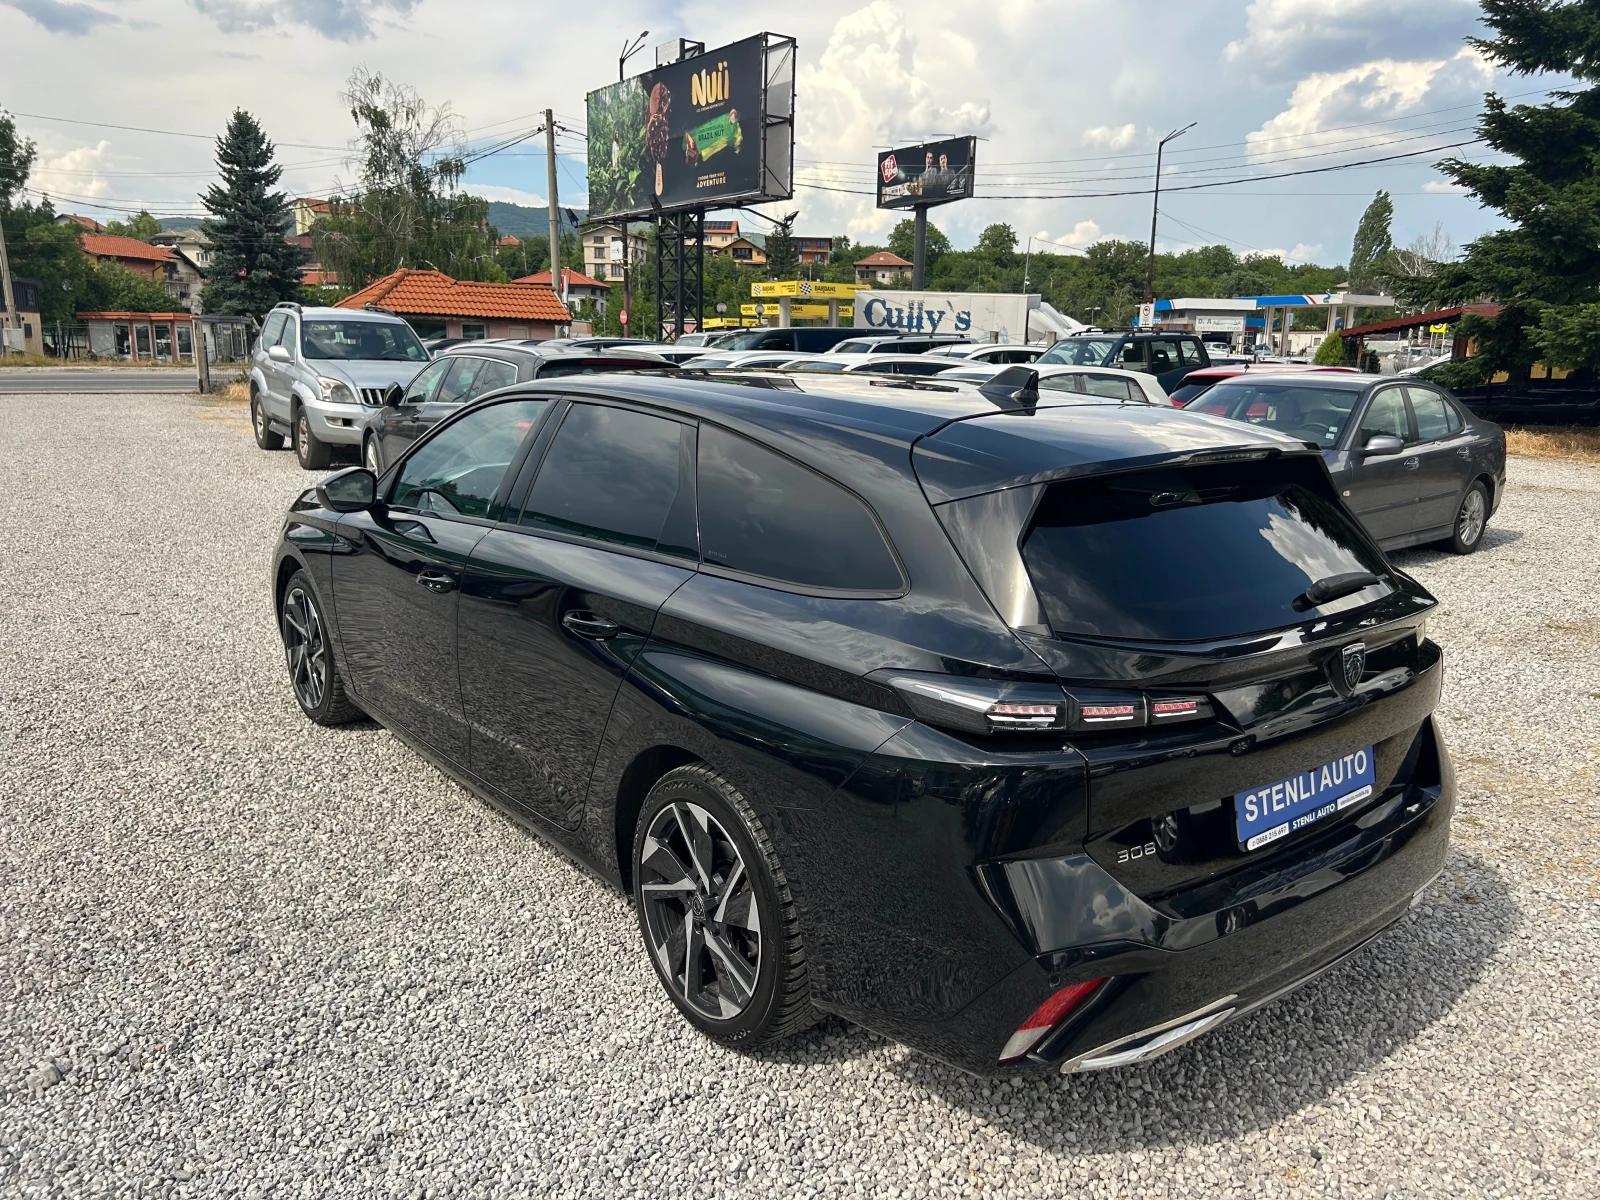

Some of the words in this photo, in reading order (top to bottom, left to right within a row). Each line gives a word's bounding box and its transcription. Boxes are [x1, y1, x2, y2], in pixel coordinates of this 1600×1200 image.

[691, 61, 729, 106] Nuii
[698, 131, 714, 141] BRAZIL
[714, 129, 724, 137] NUT
[696, 176, 726, 188] ADVENTURE
[1245, 771, 1315, 822] STENLI
[1320, 750, 1367, 792] AUTO
[1292, 813, 1315, 829] STENLI
[1316, 803, 1335, 819] AUTO
[1117, 841, 1156, 864] 308
